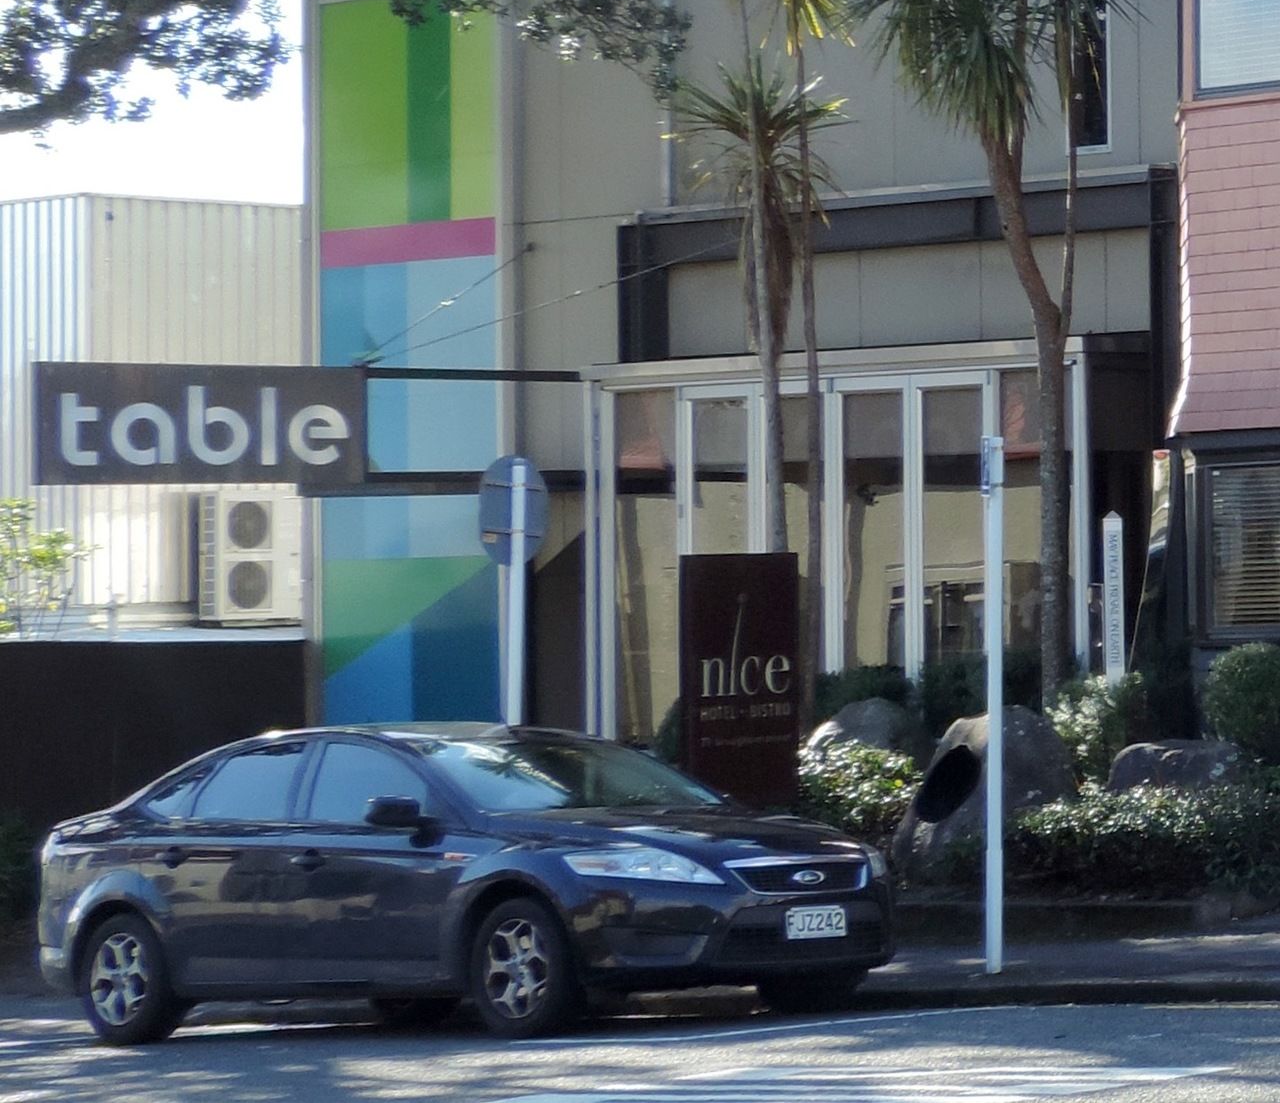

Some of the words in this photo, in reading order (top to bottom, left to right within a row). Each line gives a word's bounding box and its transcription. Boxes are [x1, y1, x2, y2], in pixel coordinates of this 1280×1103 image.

[60, 385, 349, 466] table
[700, 705, 736, 721] HOTEL
[787, 911, 844, 932] FJZ242
